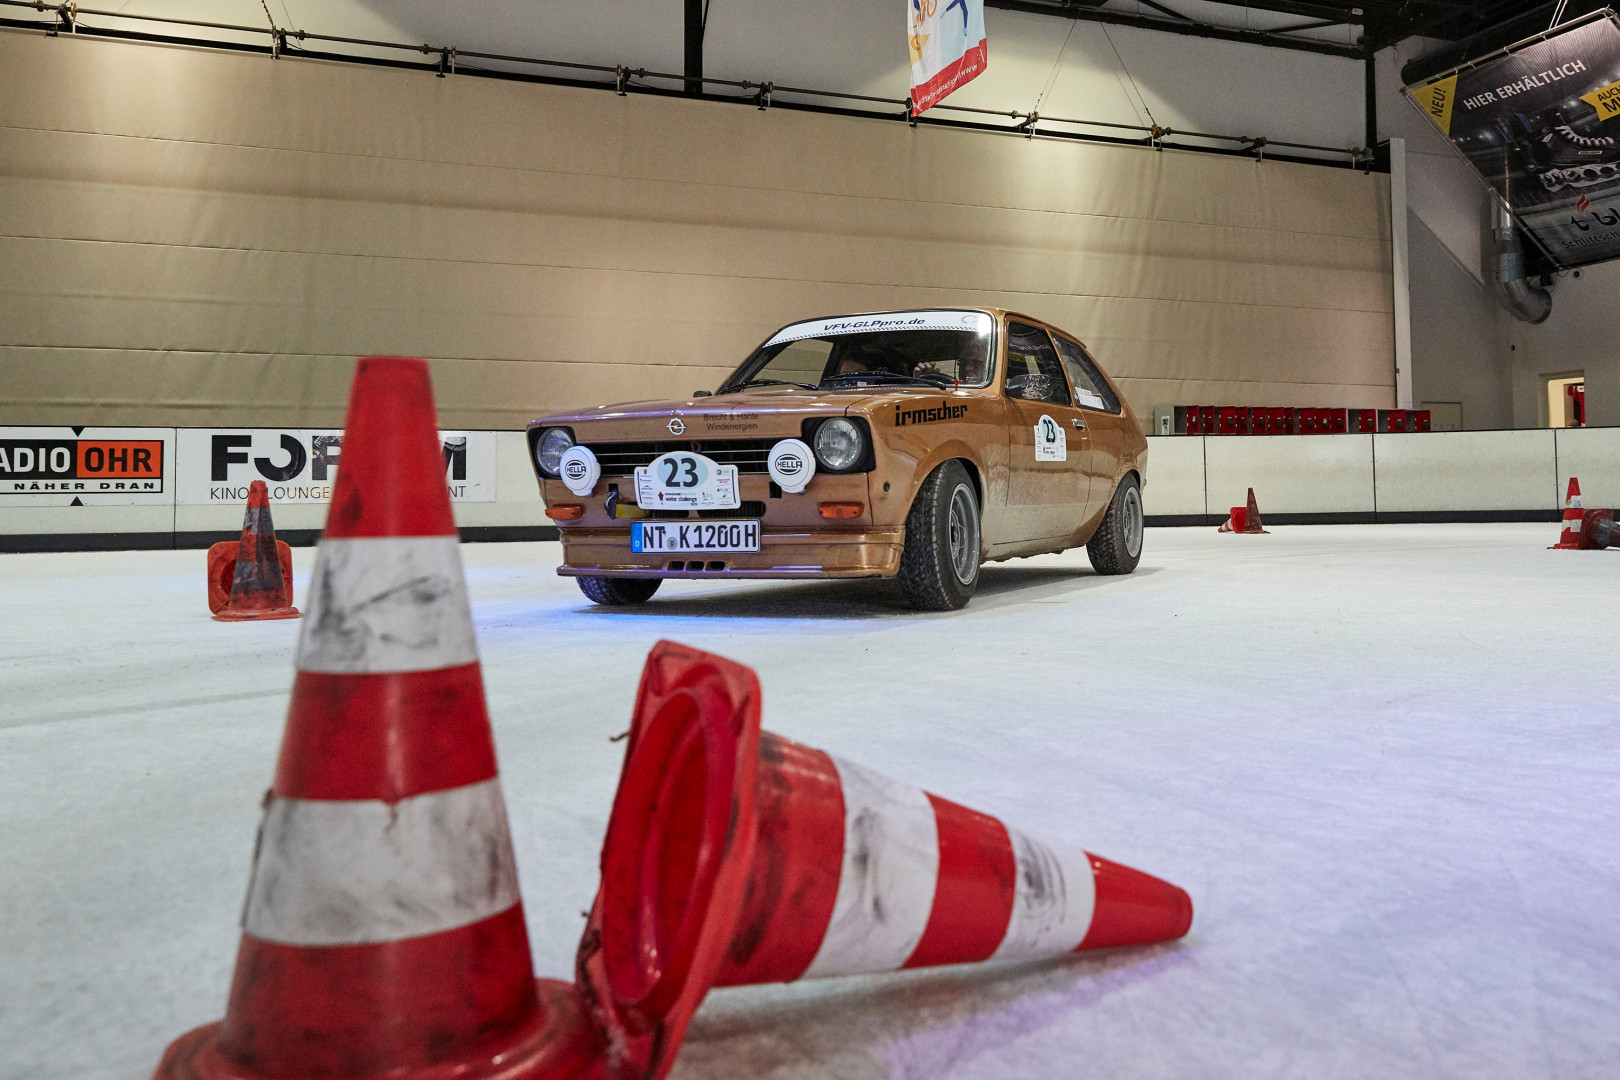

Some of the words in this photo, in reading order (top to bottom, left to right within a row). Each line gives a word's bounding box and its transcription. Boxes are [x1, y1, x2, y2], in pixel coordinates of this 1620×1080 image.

[1463, 91, 1498, 110] HIER
[1495, 59, 1587, 99] ERHÄLTLICH
[1431, 87, 1447, 118] NEU!
[1561, 229, 1620, 248] Schlittsch
[824, 318, 925, 331] VFV-GLPpro.de
[703, 413, 728, 421] Brecht
[729, 413, 735, 421] &
[895, 401, 968, 427] irmscher
[706, 422, 758, 431] Windenergien
[1043, 419, 1056, 443] 23
[84, 447, 153, 473] OHR
[777, 461, 803, 469] HELLA
[663, 457, 699, 488] 23
[14, 481, 85, 491] NÄHER
[100, 482, 155, 490] DRAN
[210, 487, 250, 500] KINO
[643, 526, 666, 549] NT
